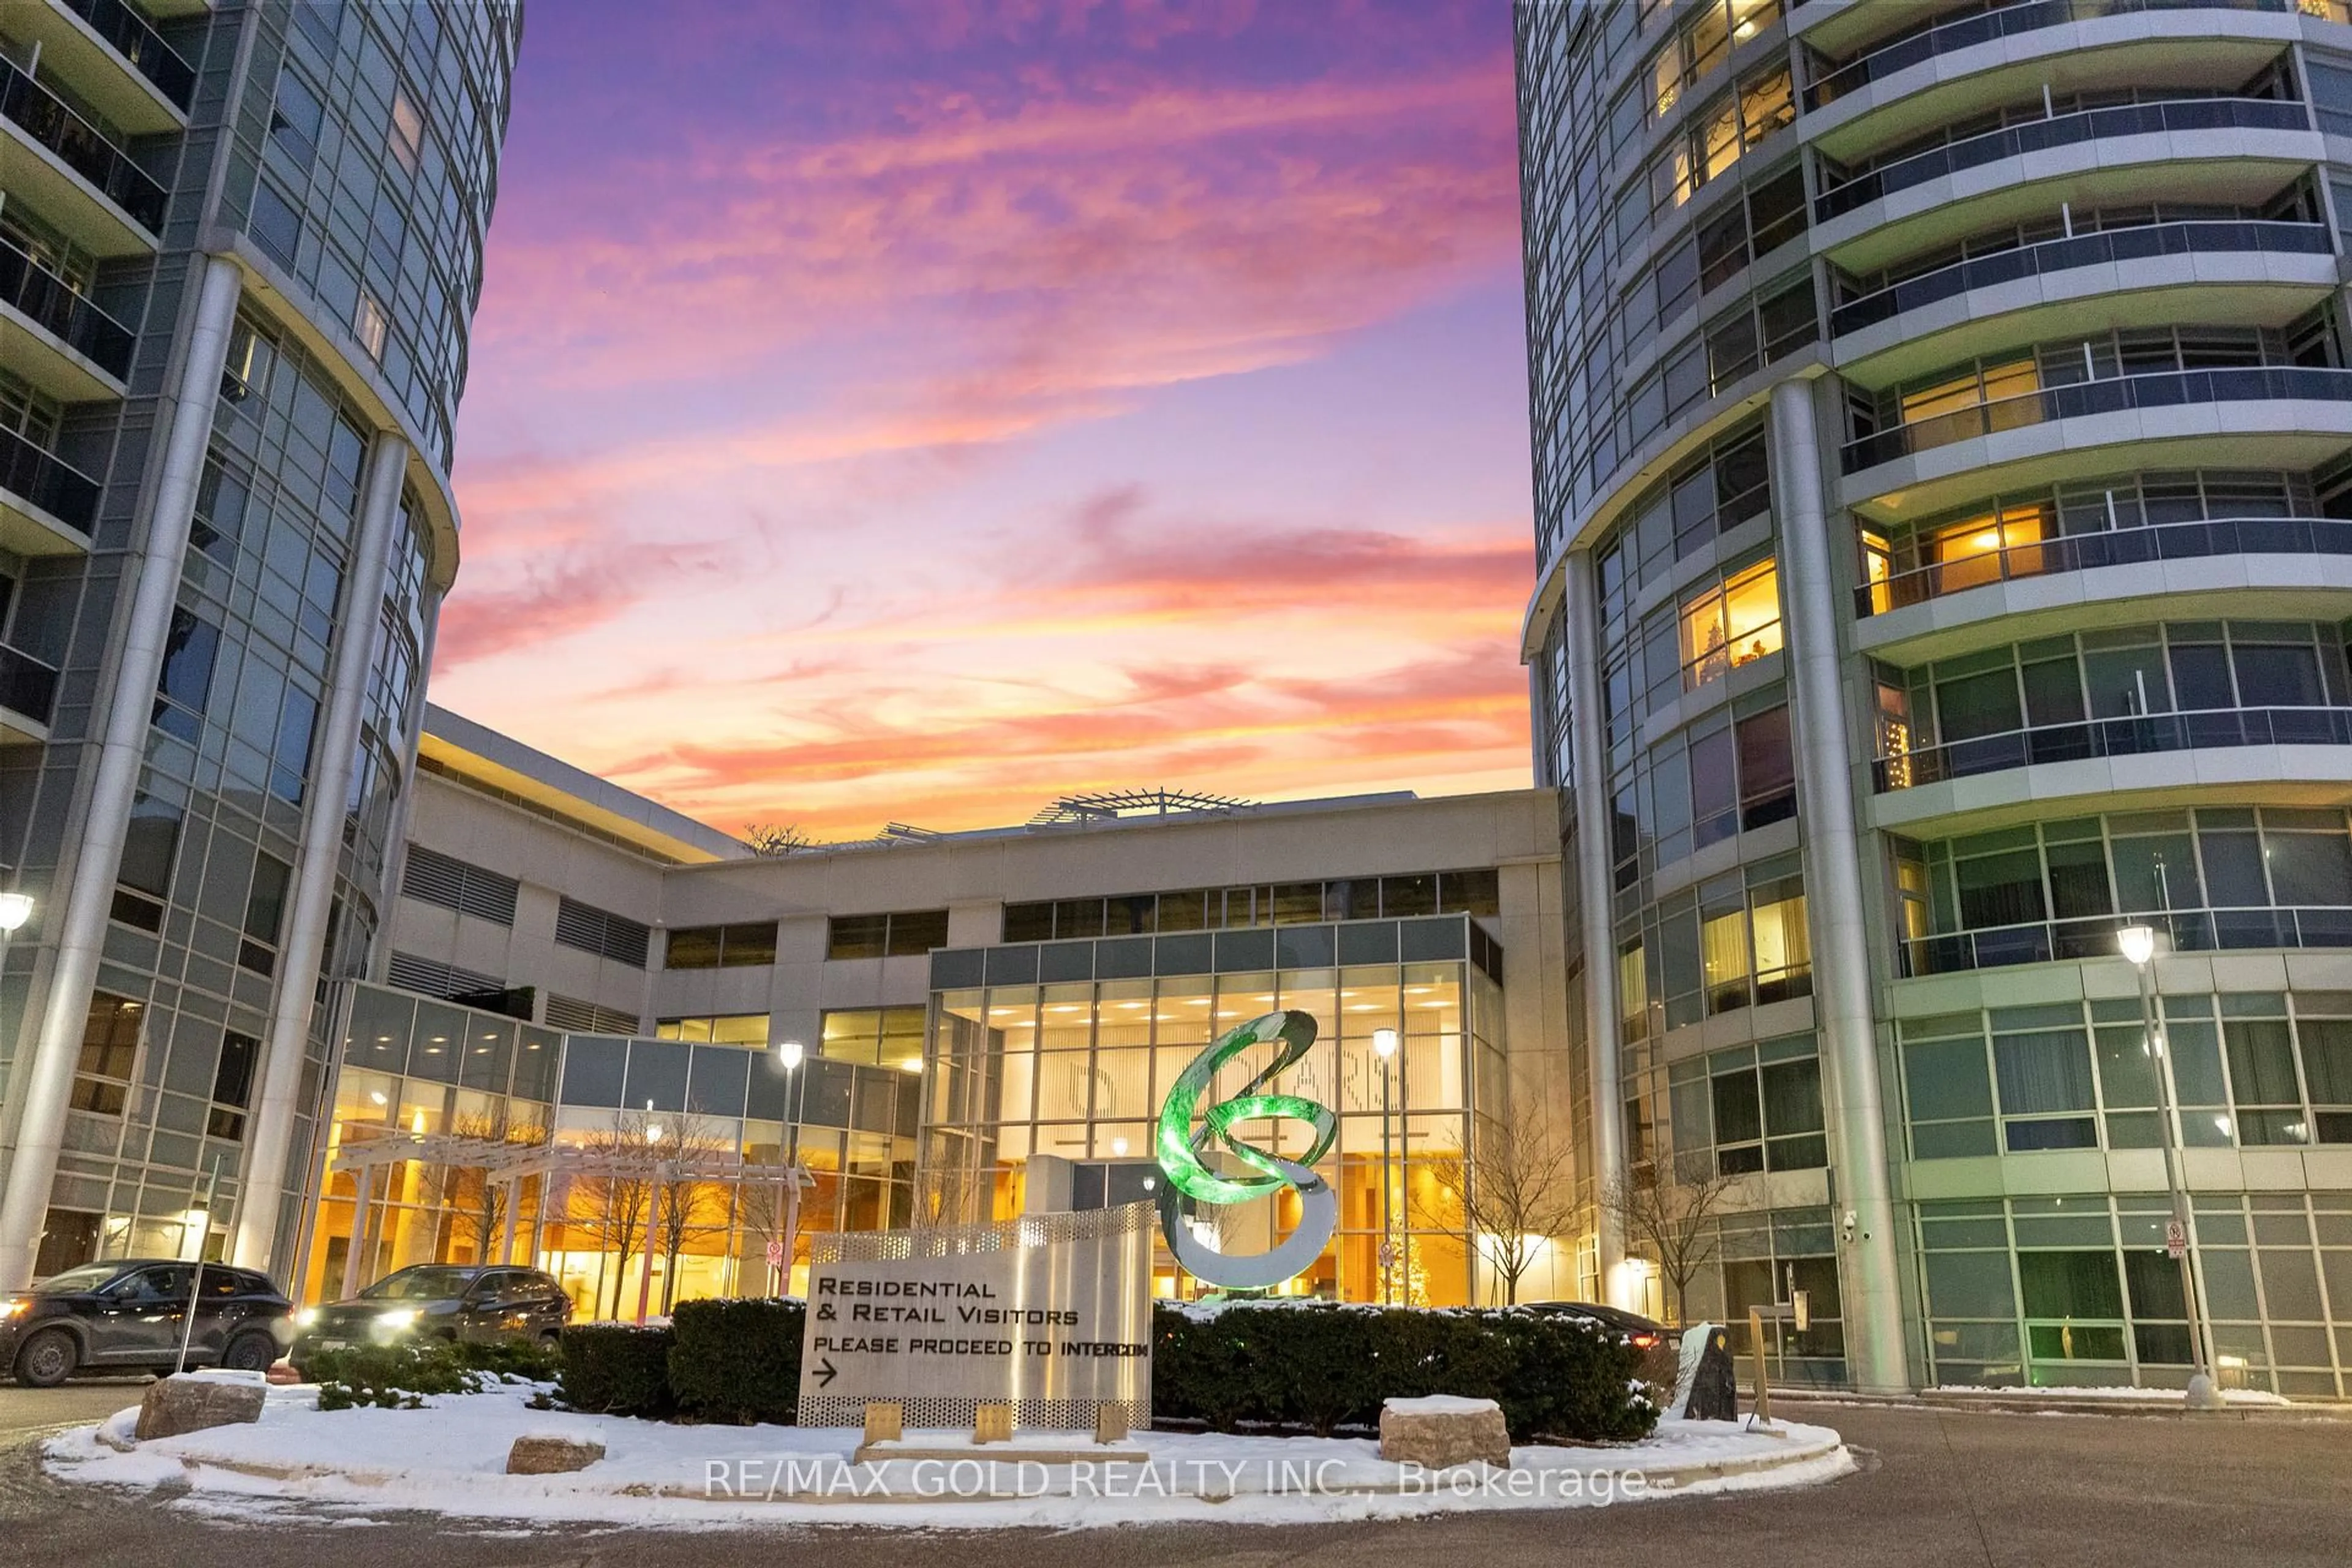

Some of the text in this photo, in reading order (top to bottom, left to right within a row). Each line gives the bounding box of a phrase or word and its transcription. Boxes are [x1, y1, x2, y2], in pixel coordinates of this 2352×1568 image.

[818, 1278, 996, 1298] RESIDENTIAL
[816, 1303, 1078, 1325] & RETAIL VISITORS
[814, 1337, 899, 1353] PLEASE
[910, 1339, 1012, 1355] PROCEED
[1023, 1341, 1051, 1355] TO
